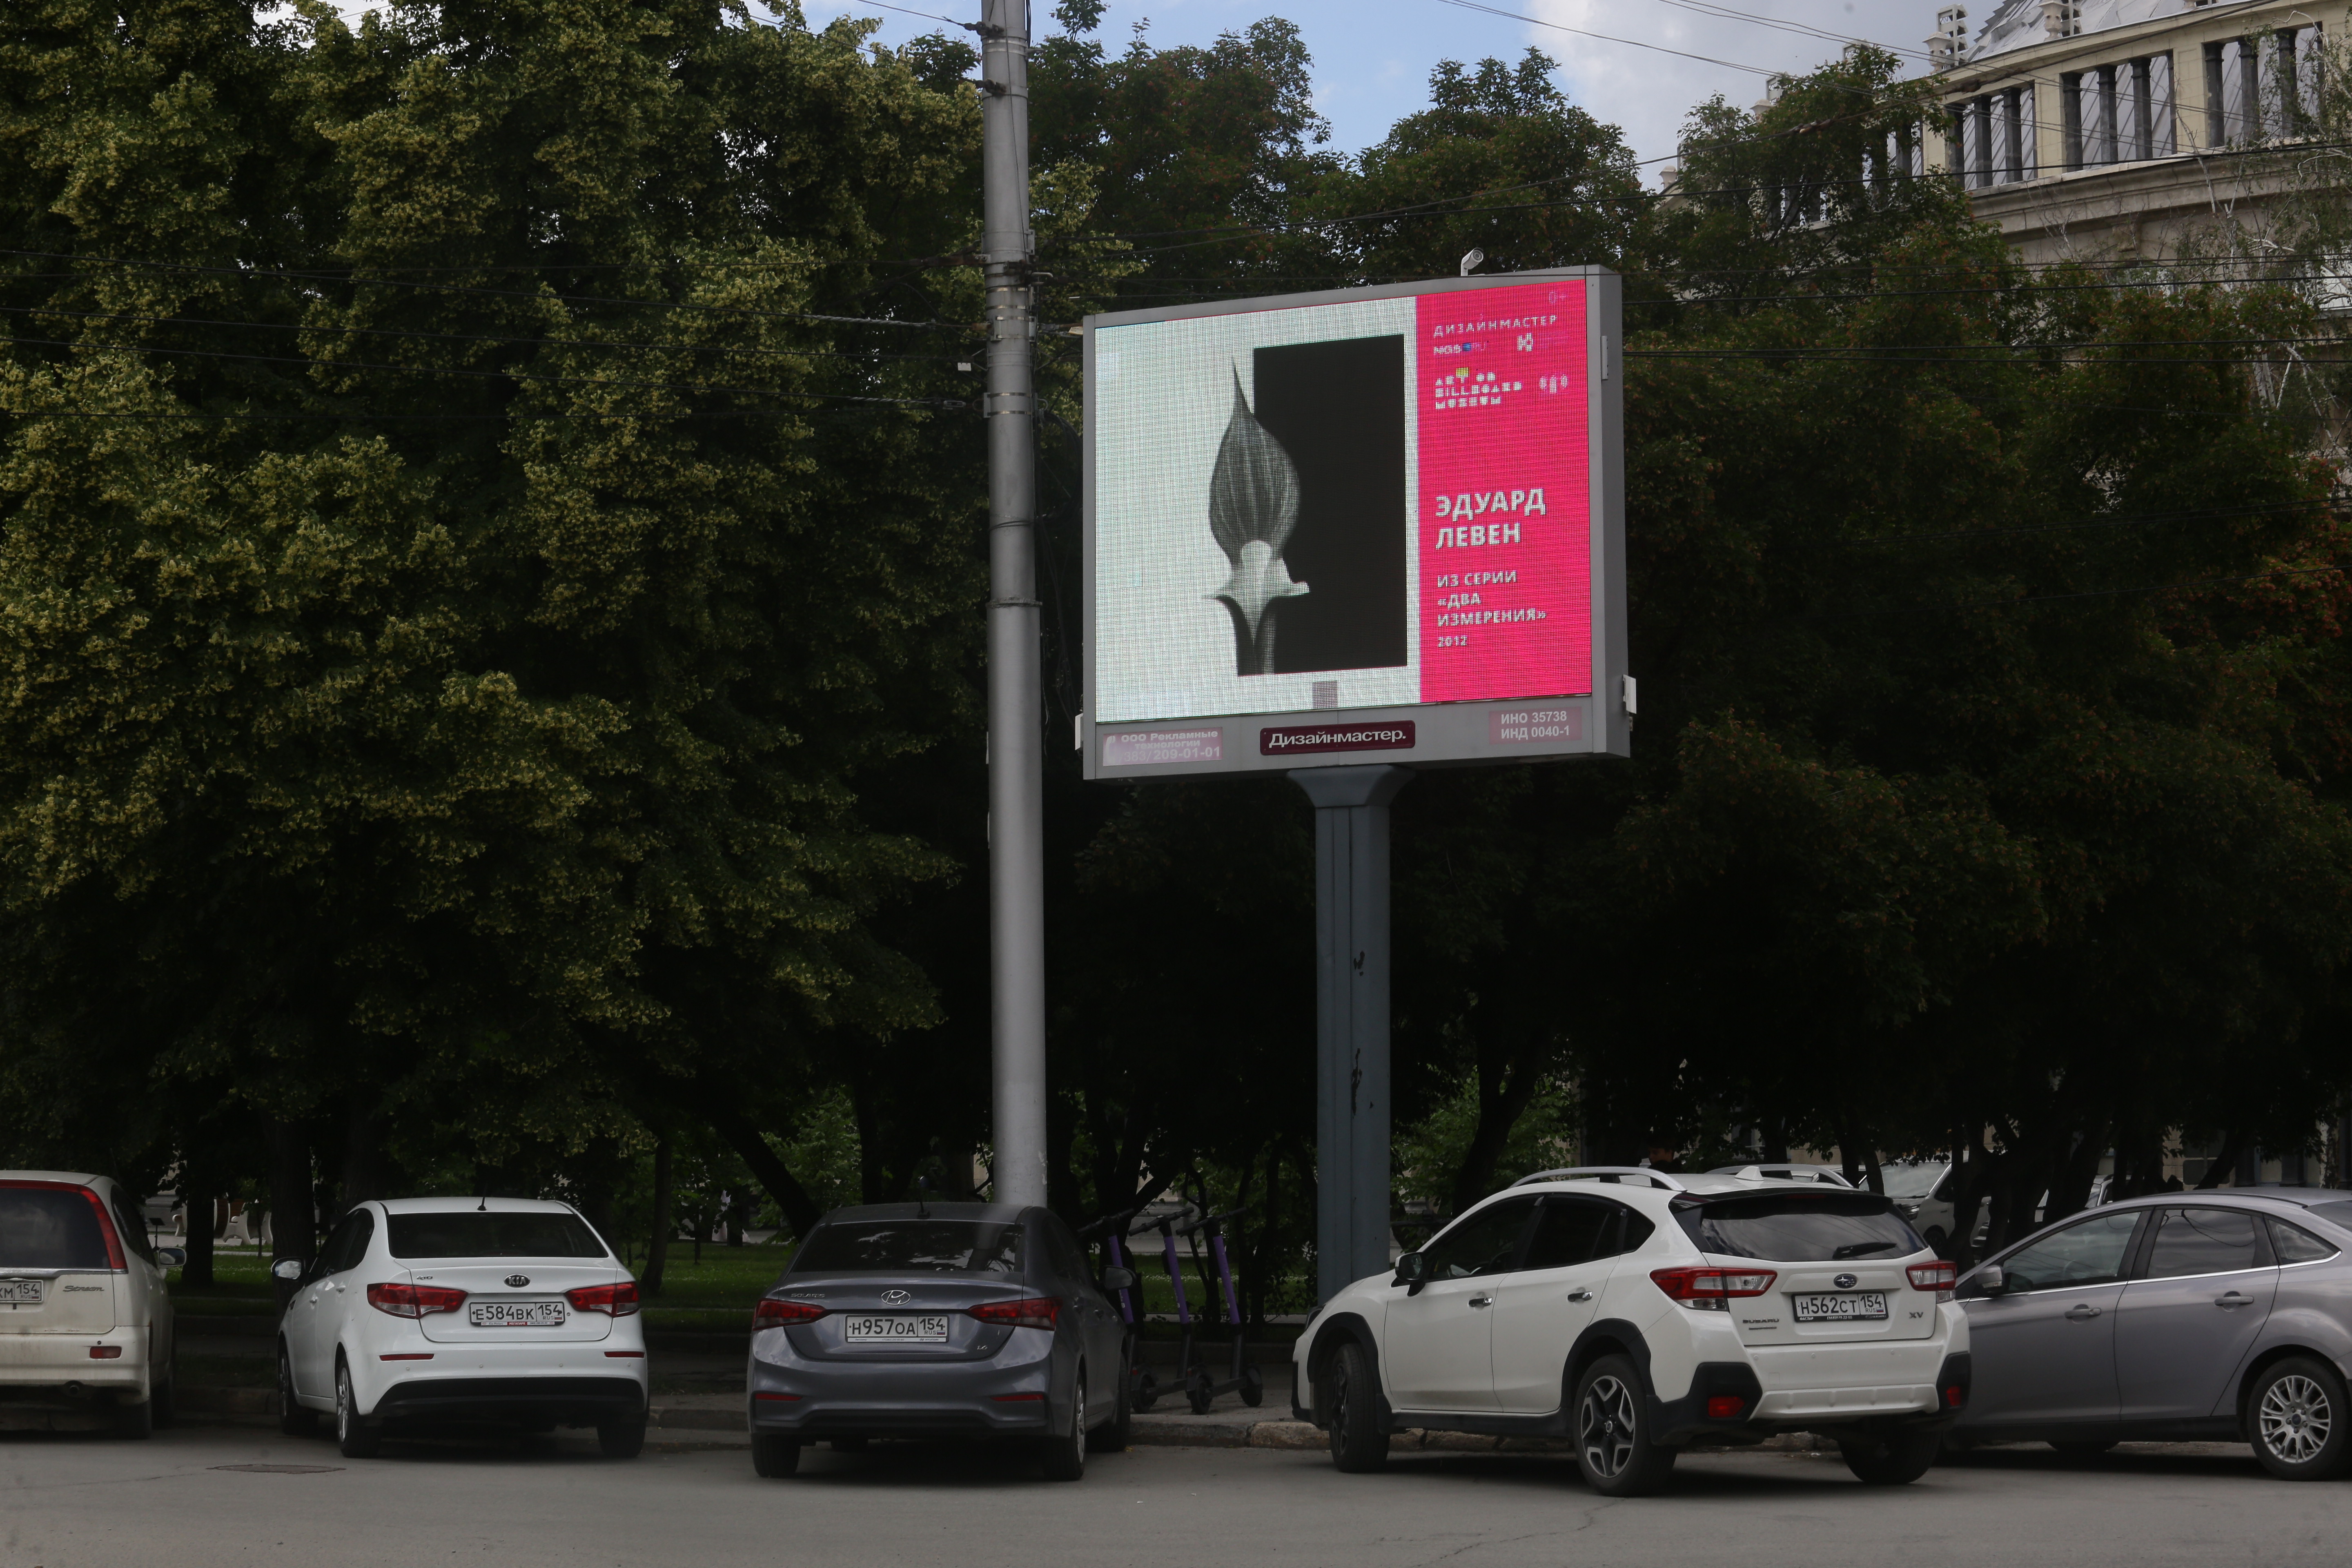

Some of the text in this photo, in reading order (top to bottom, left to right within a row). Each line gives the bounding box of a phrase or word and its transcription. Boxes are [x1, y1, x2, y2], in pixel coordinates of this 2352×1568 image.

[1433, 314, 1557, 338] ДИЗАЙНМАСТЕР
[1435, 488, 1547, 522] ЭДУАРД
[1435, 522, 1521, 550] ЛЕВЕН
[1437, 570, 1517, 588] ИЗ СЕРИИ
[1437, 592, 1482, 610] «ДВА
[1437, 608, 1547, 627] ИЗМЕРЕНИЯ»
[1437, 635, 1468, 648] 2012
[1501, 710, 1567, 724] ИНО 35738
[1121, 731, 1218, 742] ООО Рекламные
[1268, 730, 1407, 748] Дизайнмастер.
[1501, 725, 1570, 741] ИНД 0040-1
[1135, 739, 1200, 750] технологии
[16, 1283, 38, 1294] 154
[476, 1304, 561, 1320] Е584ВК 154
[1800, 1295, 1882, 1314] Н562СТ 154
[852, 1318, 943, 1335] Н957ОА 154
